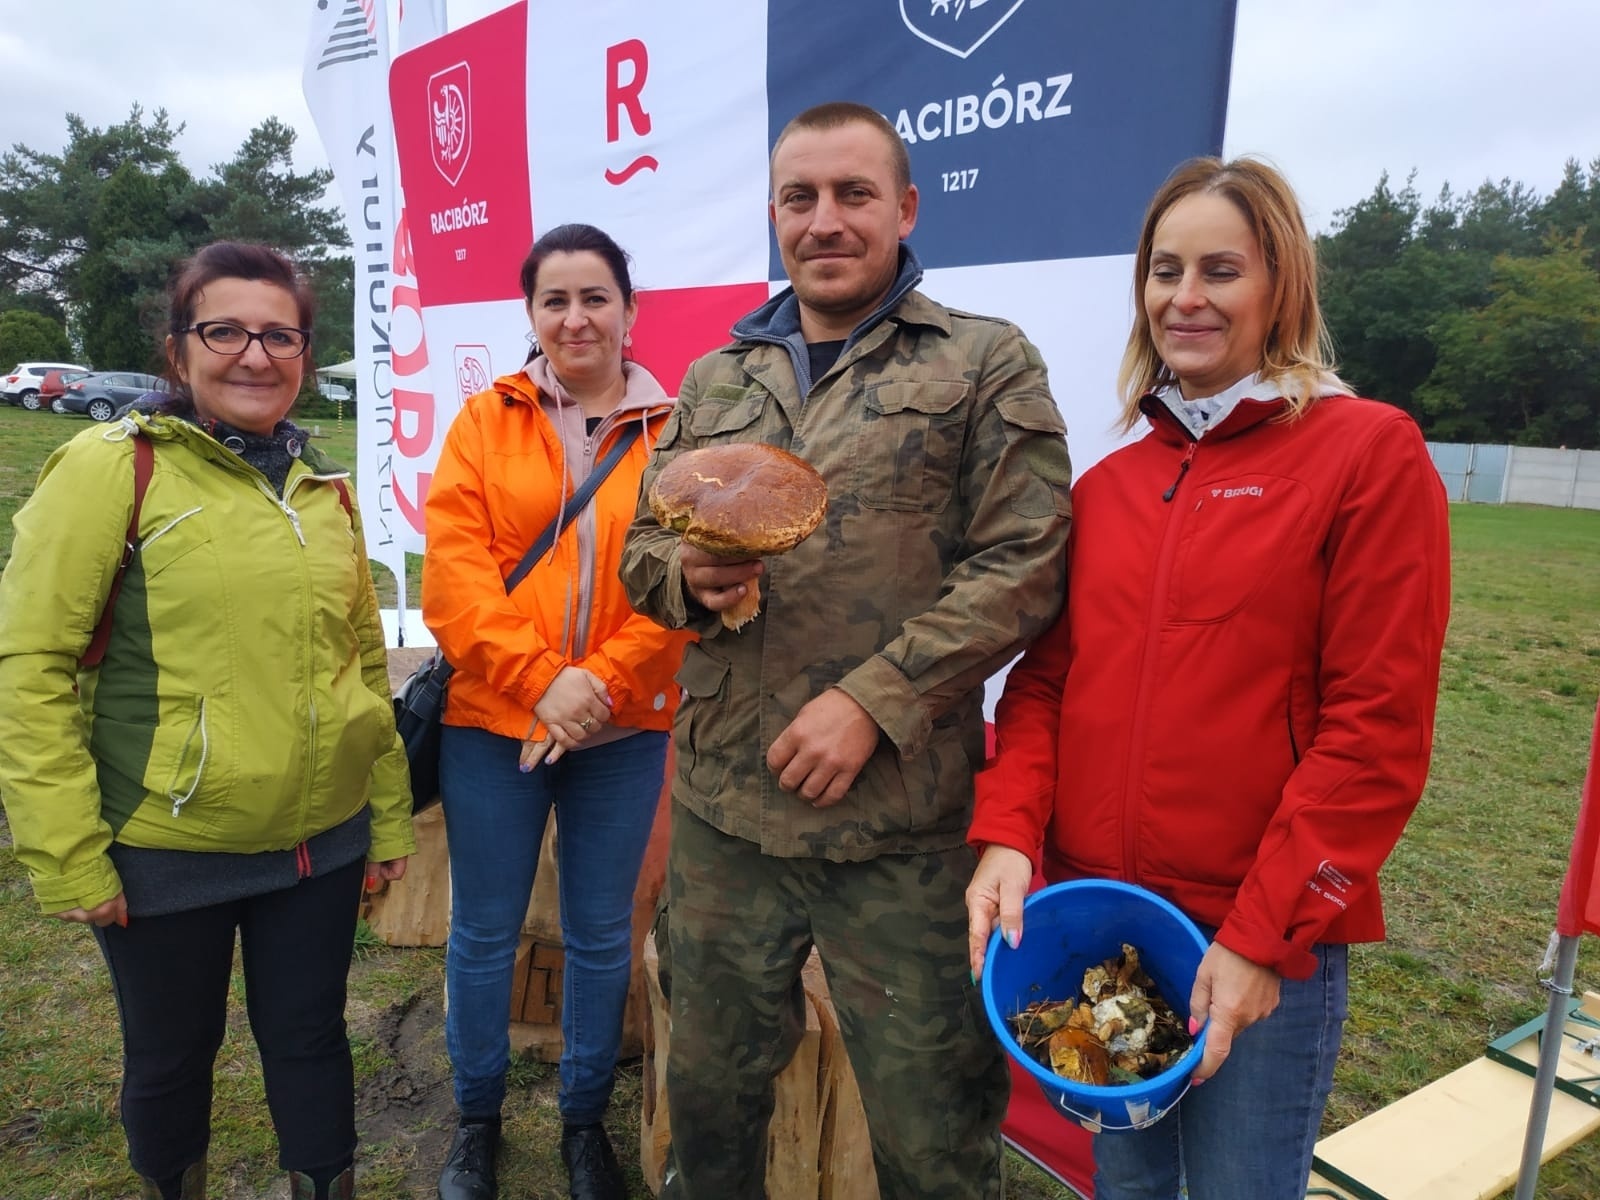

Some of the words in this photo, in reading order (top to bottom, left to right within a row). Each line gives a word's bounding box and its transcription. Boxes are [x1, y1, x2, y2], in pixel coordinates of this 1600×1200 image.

[606, 39, 652, 143] R
[882, 73, 1073, 144] ACIBÓRZ
[941, 168, 979, 192] 1217
[430, 196, 489, 235] RACIBÓRZ
[1223, 486, 1264, 498] BRUGI
